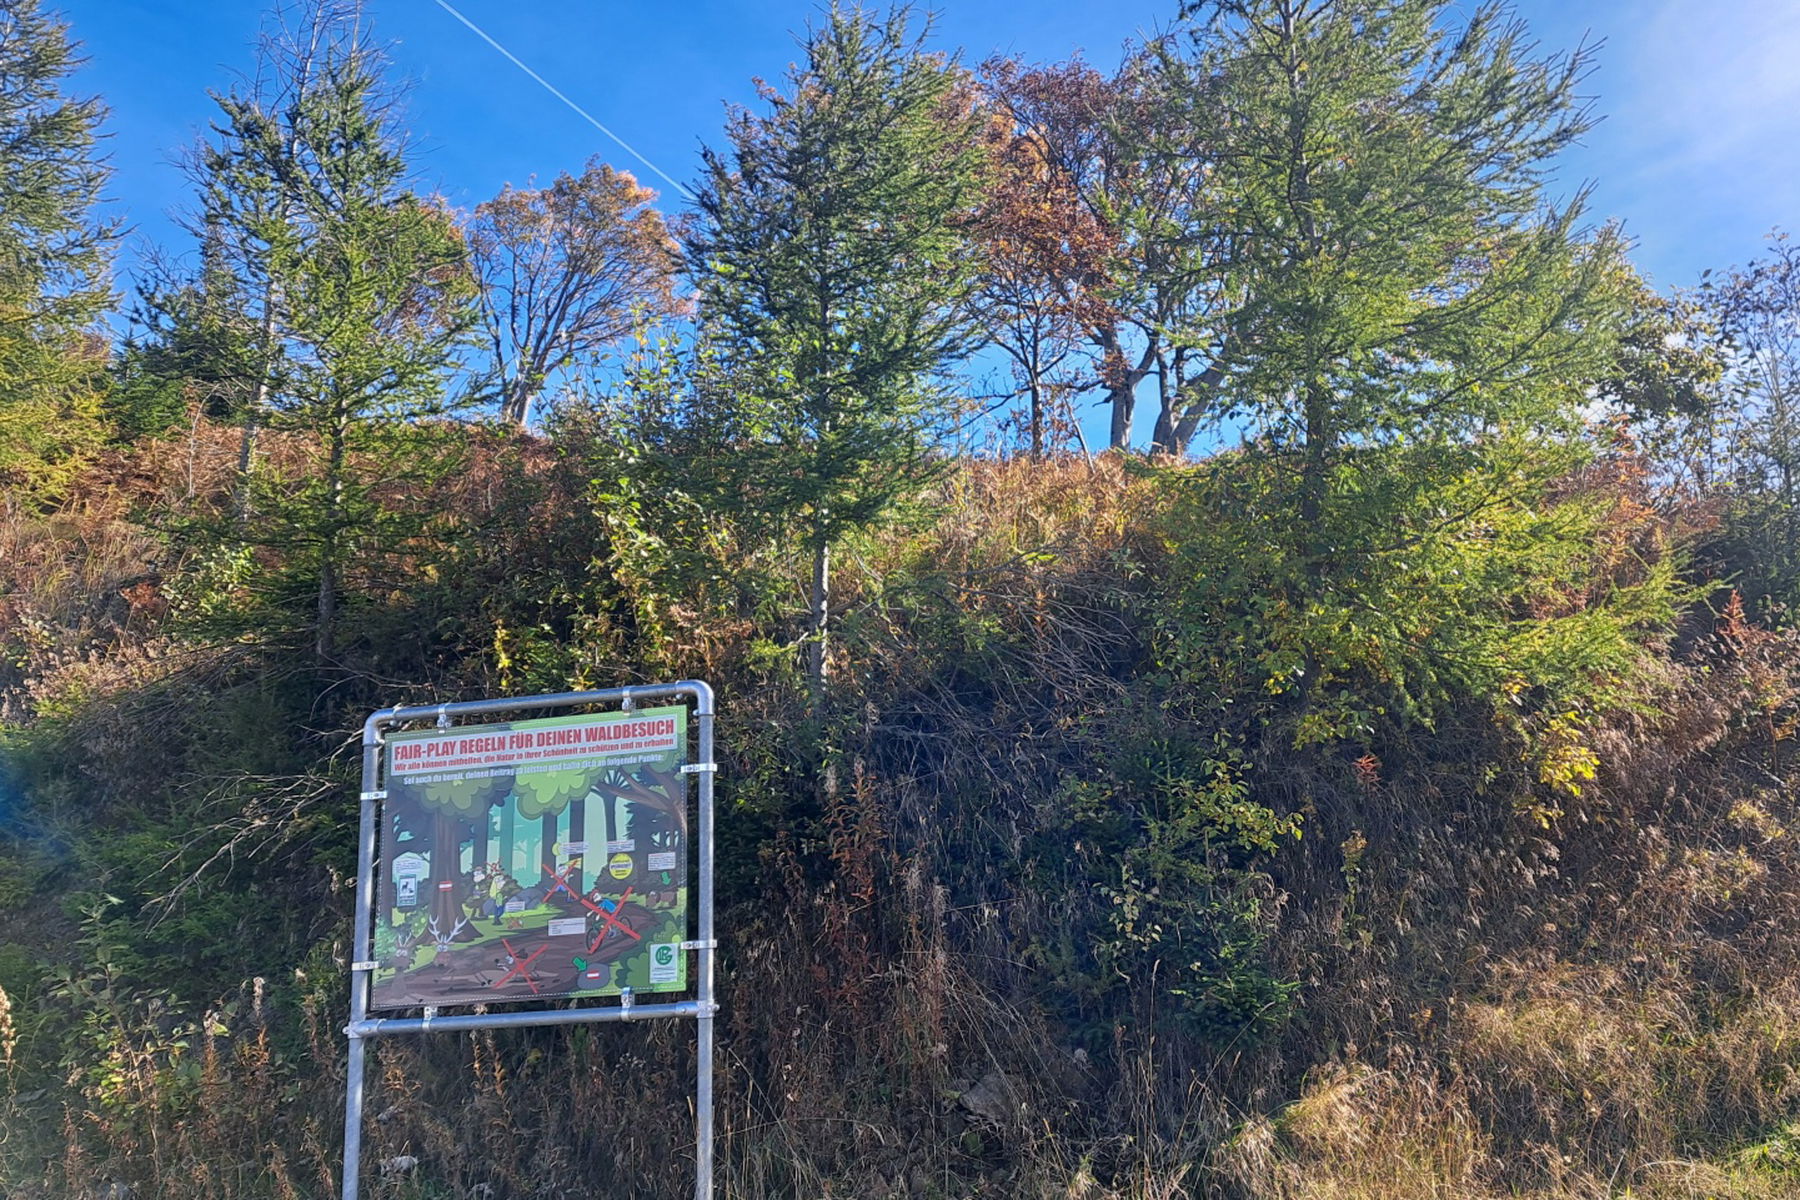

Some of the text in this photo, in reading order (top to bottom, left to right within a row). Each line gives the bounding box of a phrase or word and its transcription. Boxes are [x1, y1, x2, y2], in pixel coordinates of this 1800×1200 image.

[394, 720, 674, 760] FAIR-PLAY REGELN FÜR DEINEN WALDBESUCH
[394, 763, 406, 771] Wir
[407, 762, 420, 770] alle
[422, 760, 447, 769] können
[484, 755, 495, 763] die
[496, 753, 515, 762] Natur
[516, 752, 523, 760] in
[543, 746, 577, 757] Schönheit
[588, 742, 619, 754] schützen
[621, 741, 633, 750] und
[635, 741, 642, 749] zu
[644, 738, 674, 748] erhalten
[403, 775, 414, 785] Sei
